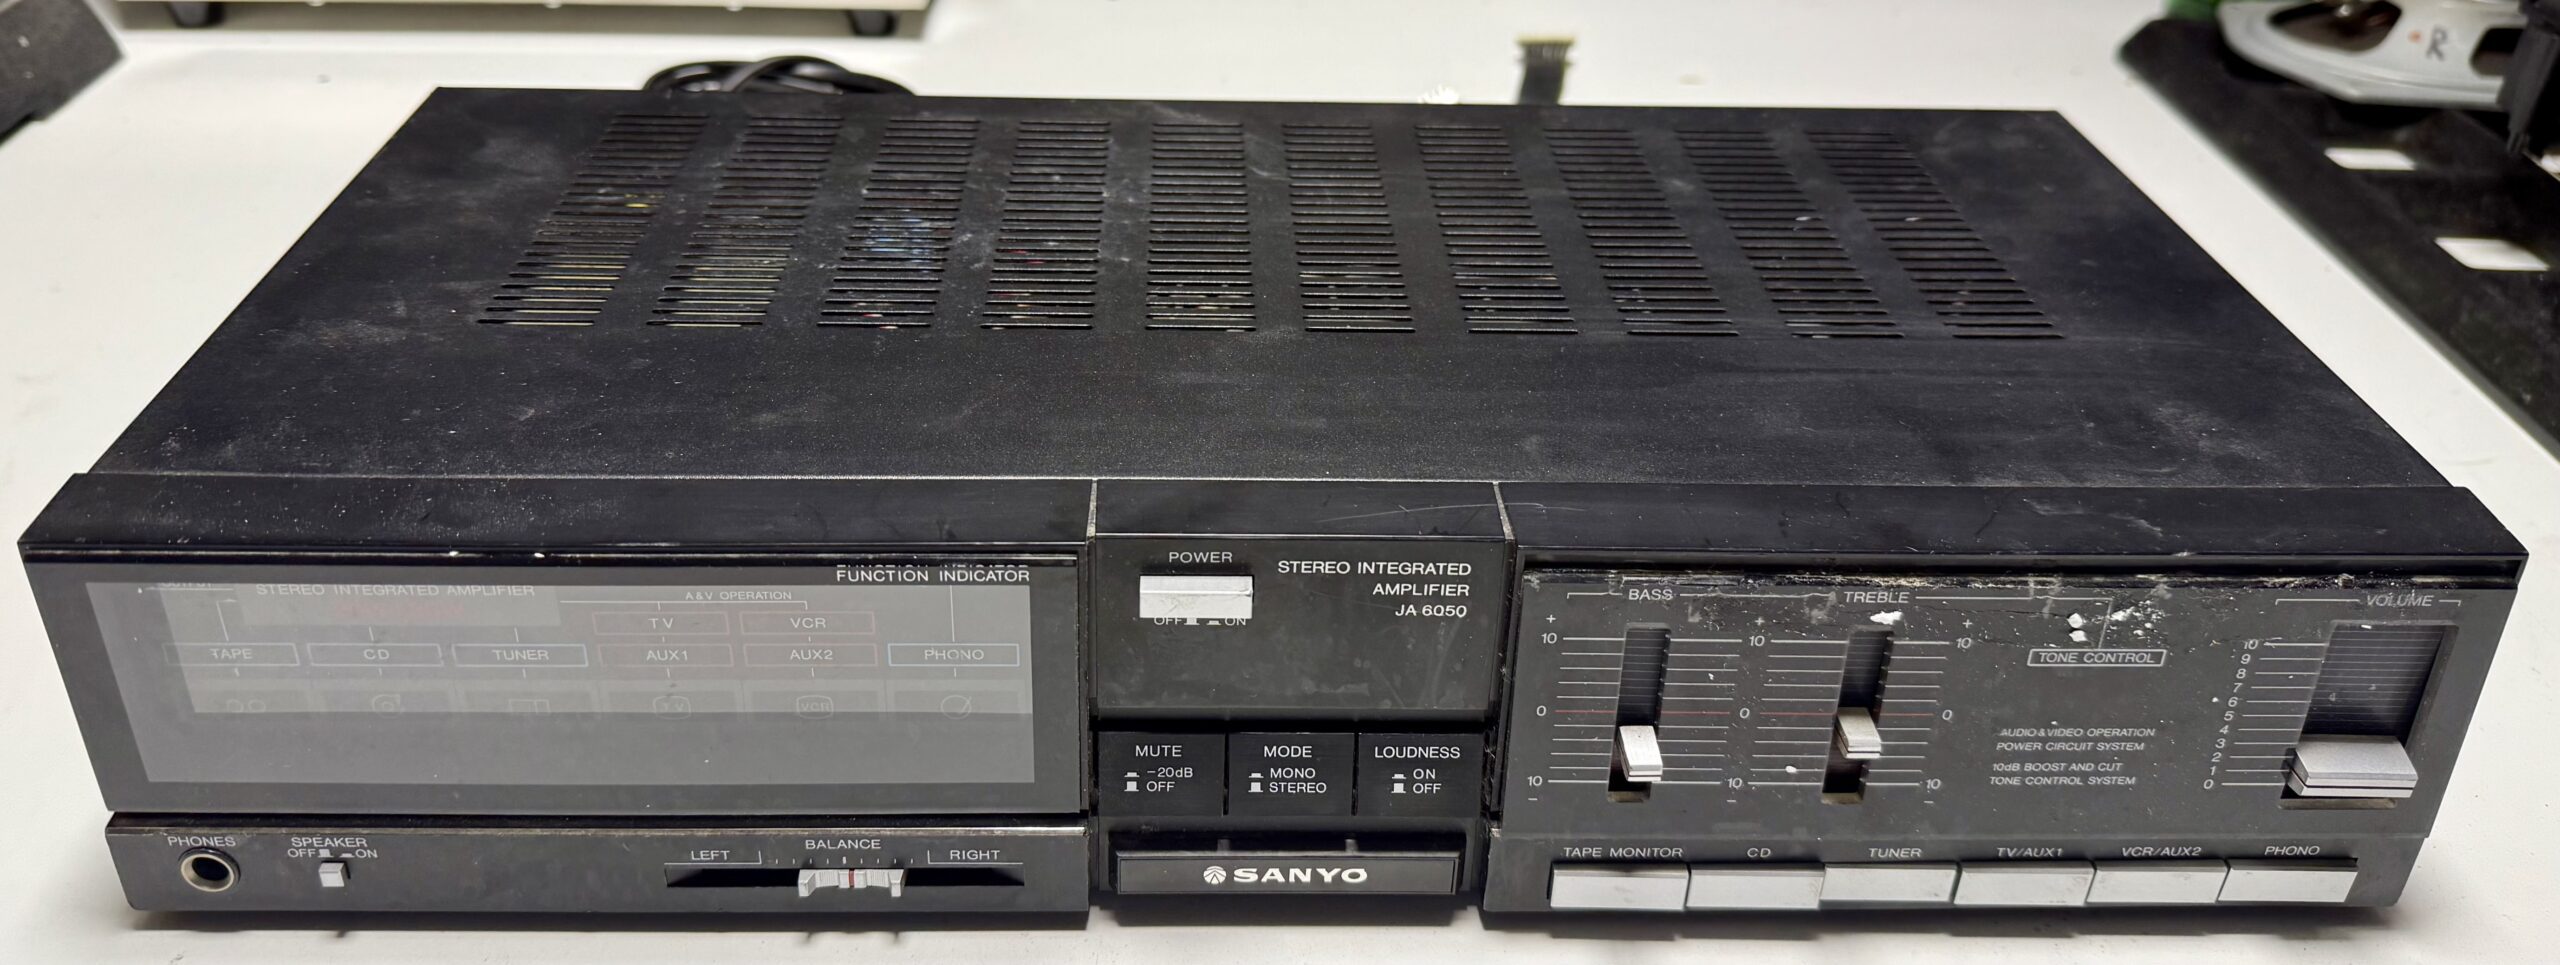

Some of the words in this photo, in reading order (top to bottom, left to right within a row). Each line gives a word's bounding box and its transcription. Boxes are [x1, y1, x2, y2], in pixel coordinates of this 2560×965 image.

[2425, 25, 2448, 61] R
[1169, 552, 1233, 563] POWER
[1277, 560, 1350, 574] STEREO
[1357, 562, 1472, 576] INTEGRATED
[836, 570, 929, 582] FUNCTION
[939, 570, 1030, 582] INDICATOR
[256, 584, 325, 595] STEREO
[334, 584, 439, 596] INTEGRATED
[447, 585, 535, 596] AMPLIFIER
[1372, 583, 1470, 596] AMPLIFIER
[1628, 589, 1673, 600] BASS
[719, 591, 792, 600] OPERATION
[1844, 591, 1909, 603] TREBLE
[2367, 594, 2434, 606] VOLUME
[1395, 605, 1417, 617] JA
[1421, 605, 1467, 618] 6050
[790, 617, 826, 629] VCR
[1154, 618, 1182, 626] OFF
[1225, 618, 1247, 626] ON
[1541, 633, 1558, 644] 10
[1748, 635, 1765, 647] 10
[1956, 637, 1972, 649] 10
[2243, 638, 2259, 650] 10
[210, 648, 253, 660] TAPE
[363, 649, 390, 660] CD
[492, 649, 550, 661] TUNER
[647, 649, 688, 661] AUX1
[790, 649, 833, 660] AUX2
[924, 649, 985, 661] PHONO
[2039, 652, 2079, 663] TONE
[2084, 652, 2155, 663] CONTROL
[2240, 653, 2251, 664] 9
[2236, 668, 2246, 679] 8
[2233, 682, 2243, 693] 7
[2228, 697, 2238, 707] 6
[1536, 706, 1547, 717] 0
[1739, 708, 1750, 719] 0
[1941, 710, 1953, 721] 0
[2224, 711, 2234, 721] 5
[2087, 728, 2156, 737] OPERATION
[2219, 725, 2229, 735] 4
[1996, 742, 2042, 751] POWER
[2045, 742, 2094, 751] CIRCUIT
[2096, 742, 2145, 751] SYSTEM
[2215, 738, 2226, 749] 3
[1135, 745, 1182, 757] MUTE
[1264, 746, 1312, 758] MODE
[1374, 746, 1461, 759] LOUDNESS
[2211, 752, 2222, 762] 2
[1993, 763, 2020, 772] 10dB
[2024, 763, 2067, 772] BOOST
[2068, 763, 2095, 772] AND
[2097, 763, 2124, 772] CUT
[2210, 766, 2216, 776] 1
[1270, 768, 1316, 779] MONO
[1413, 769, 1436, 780] ON
[1527, 775, 1542, 786] 10
[1727, 777, 1743, 789] 10
[1925, 779, 1942, 790] 10
[1989, 776, 2022, 785] TONE
[2025, 776, 2084, 785] CONTROL
[2087, 776, 2136, 785] SYSTEM
[2203, 779, 2214, 790] 0
[1146, 781, 1176, 792] OFF
[1269, 782, 1327, 793] STEREO
[1412, 783, 1442, 794] OFF
[167, 836, 237, 847] PHONES
[291, 837, 368, 847] SPEAKER
[805, 839, 881, 849] BALANCE
[288, 849, 316, 858] OFF
[356, 849, 378, 858] ON
[691, 850, 730, 861] LEFT
[950, 849, 1000, 861] RIGHT
[1563, 848, 1602, 858] TAPE
[1610, 848, 1683, 858] MONITOR
[1747, 848, 1771, 858] CD
[1869, 848, 1923, 858] TUNER
[1997, 847, 2064, 857] TV/AUX1
[2122, 847, 2202, 857] VCR/AUX2
[2264, 845, 2321, 856] PHONO
[1233, 867, 1368, 884] SANYO
